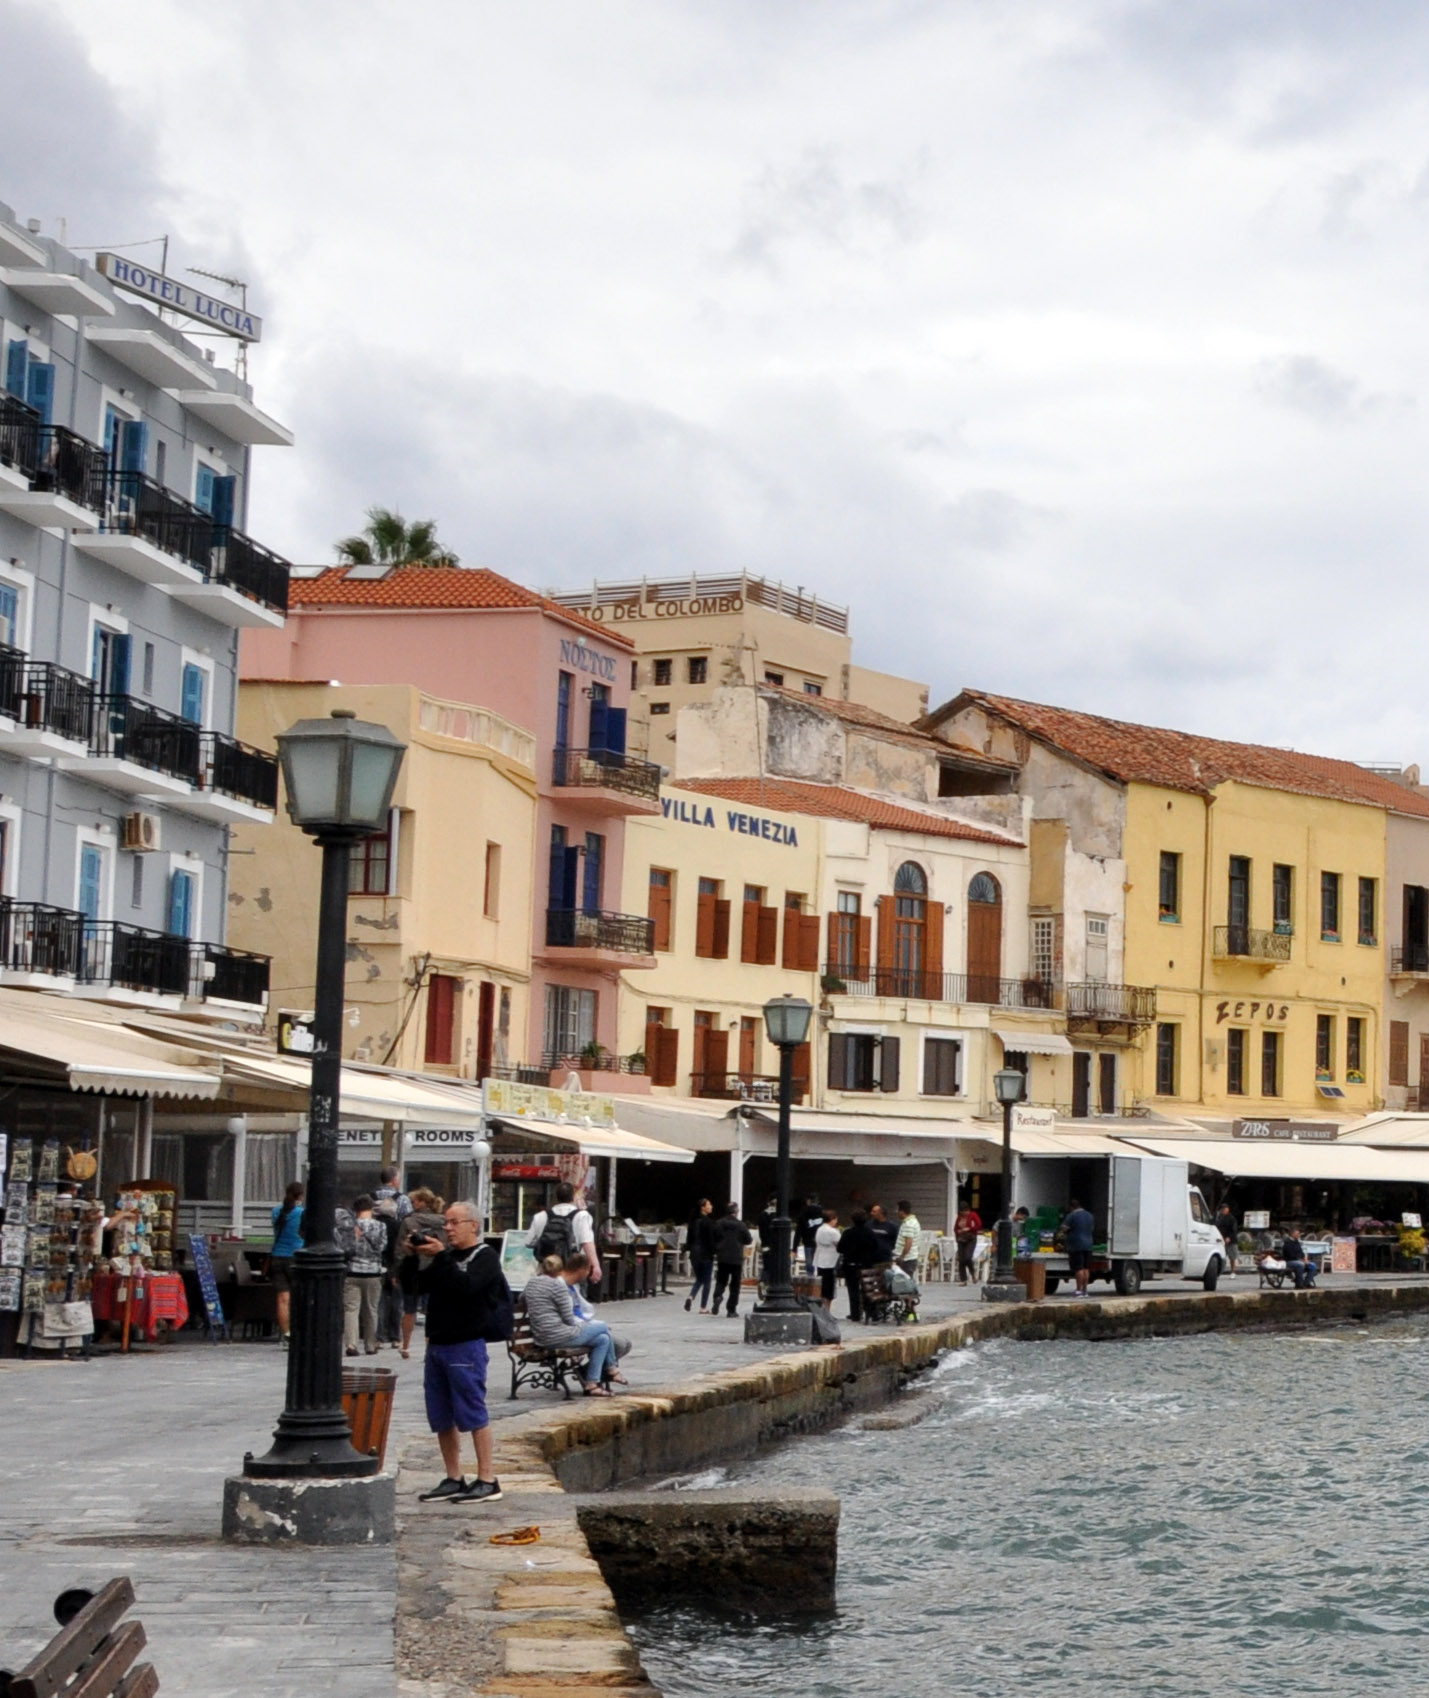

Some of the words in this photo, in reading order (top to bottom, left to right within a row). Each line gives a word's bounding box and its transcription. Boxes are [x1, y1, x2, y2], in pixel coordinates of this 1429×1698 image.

[114, 259, 187, 307] HOTEL
[195, 295, 254, 336] LUCIA
[613, 603, 647, 620] DEL
[655, 598, 743, 617] COLOMBO
[661, 797, 716, 829] VILLA
[727, 811, 798, 848] VENEZIA
[415, 1131, 475, 1142] ROOMS
